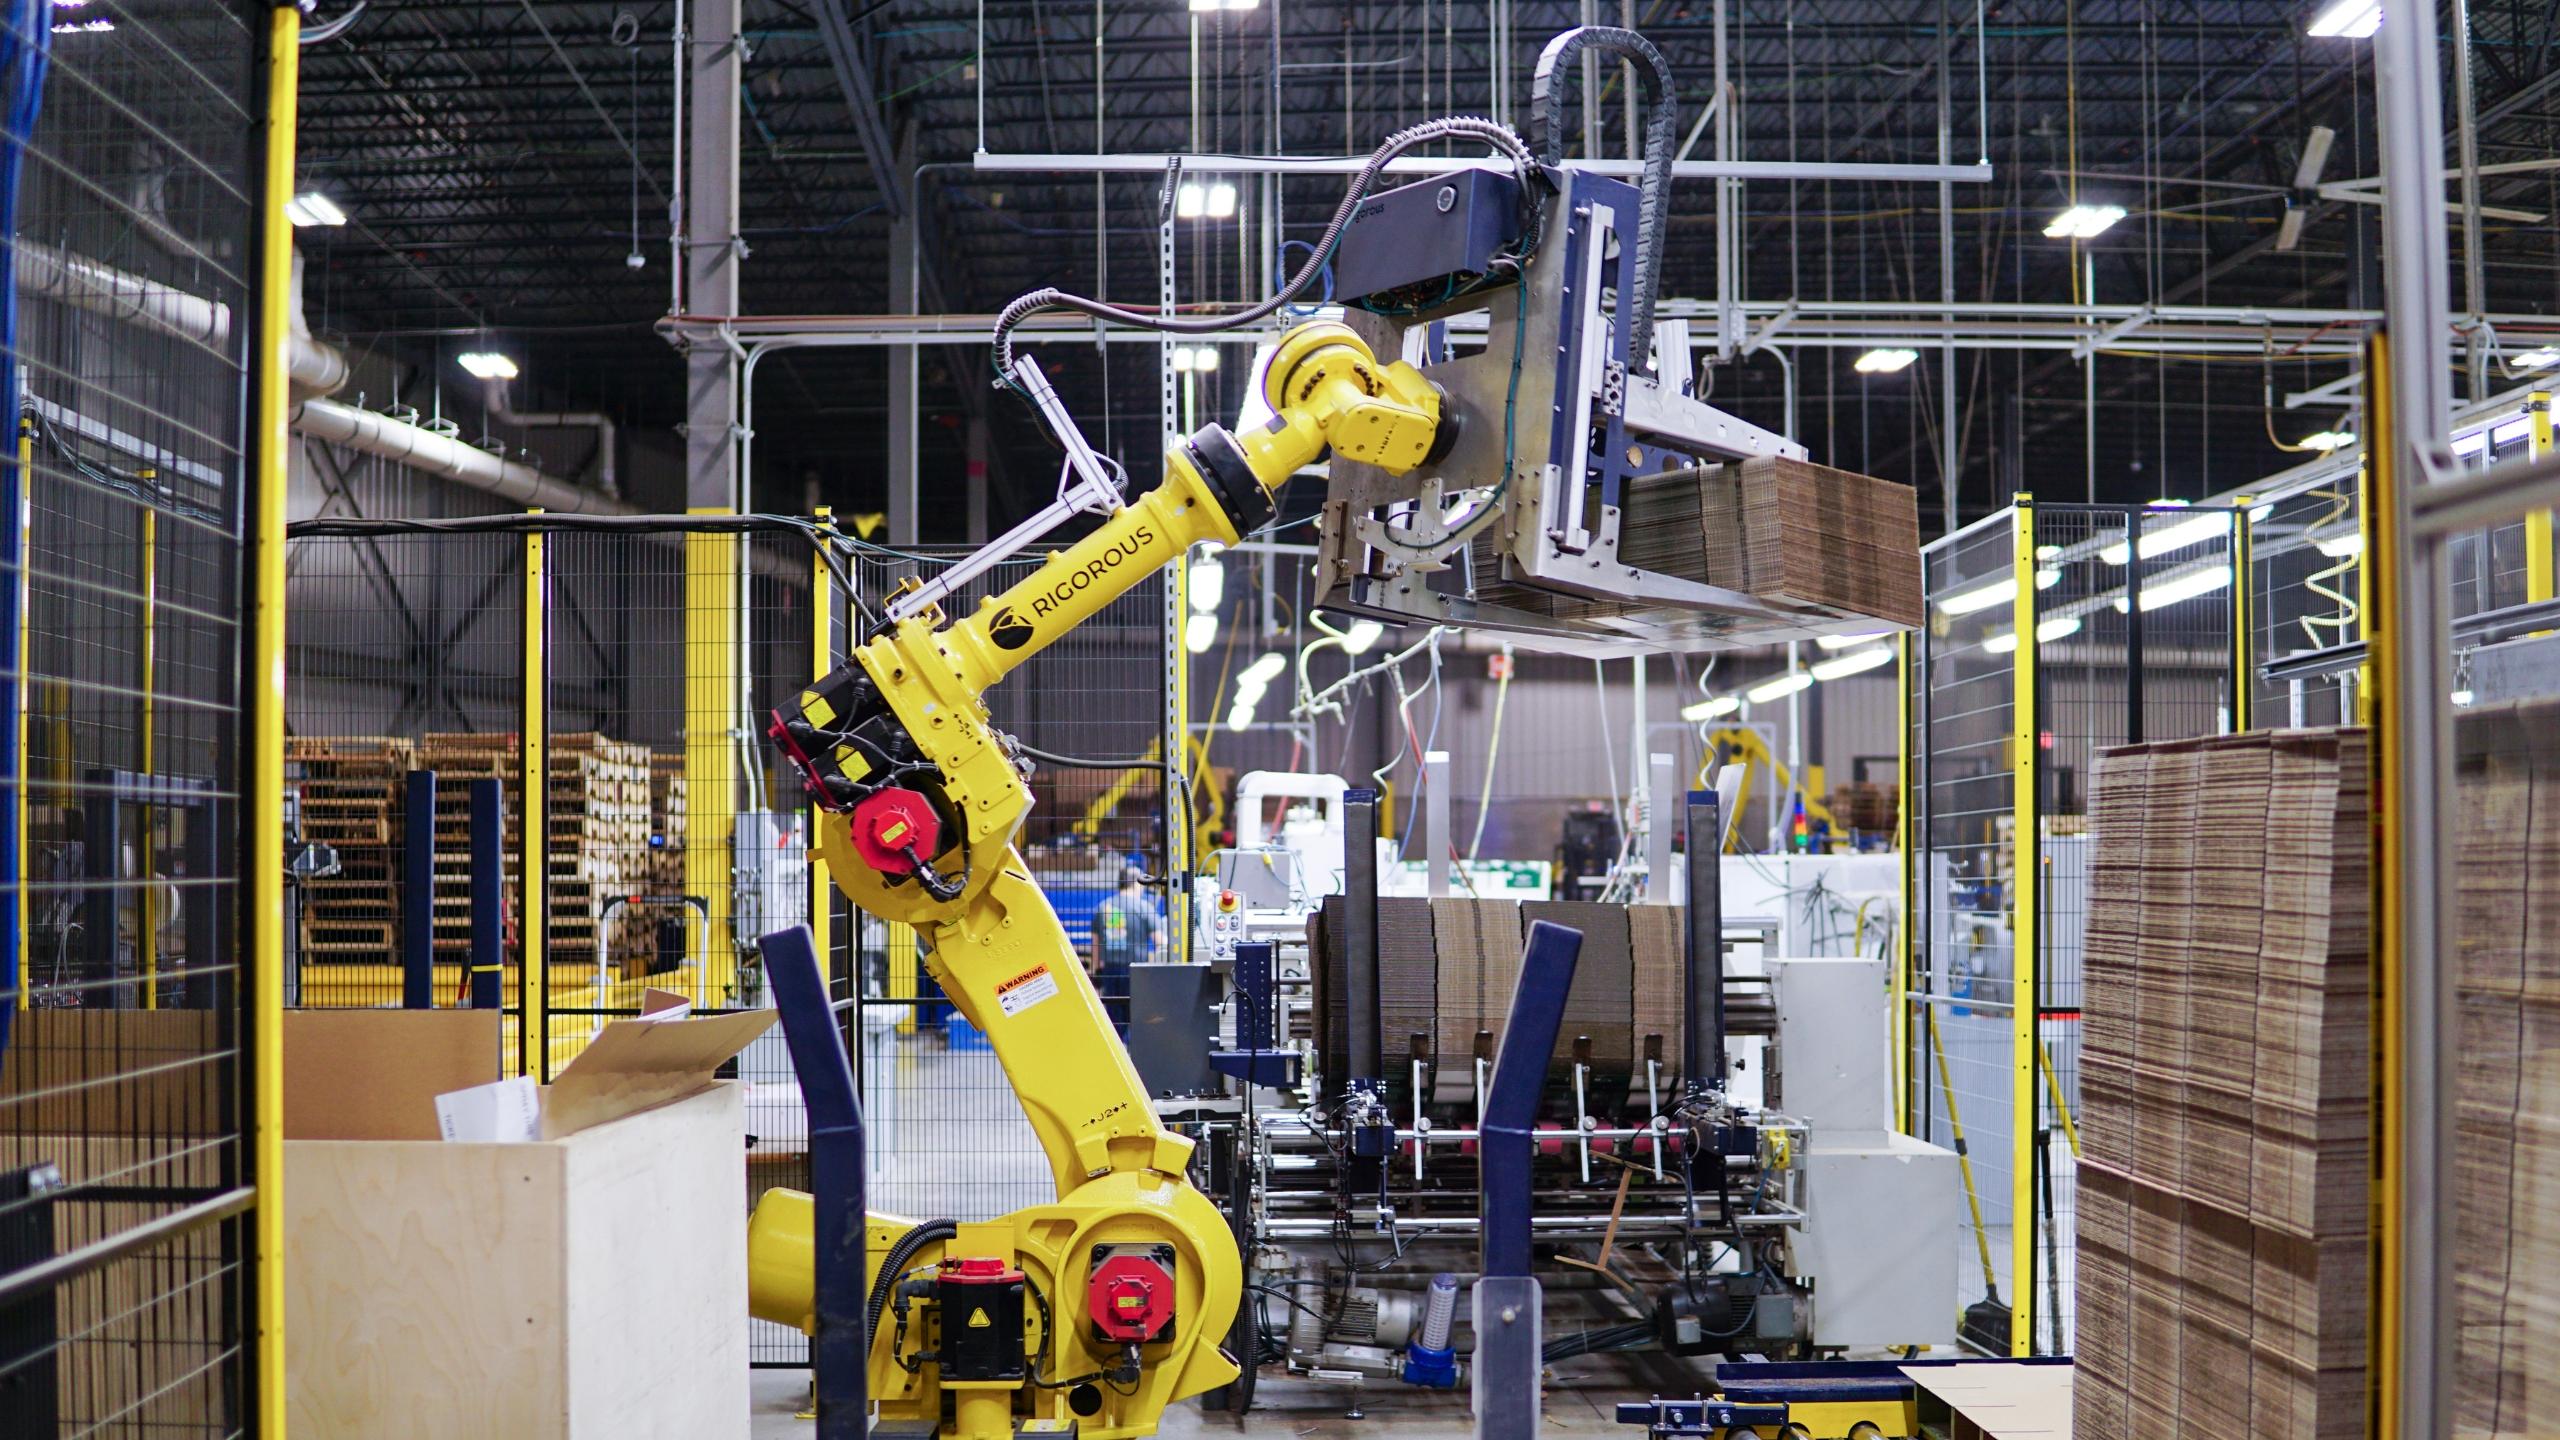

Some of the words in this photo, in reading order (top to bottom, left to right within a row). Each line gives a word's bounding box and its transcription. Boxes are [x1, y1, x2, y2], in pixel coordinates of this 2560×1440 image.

[1353, 203, 1385, 224] gorous
[1032, 526, 1153, 618] RIGOROUS
[1005, 966, 1045, 989] WARNING
